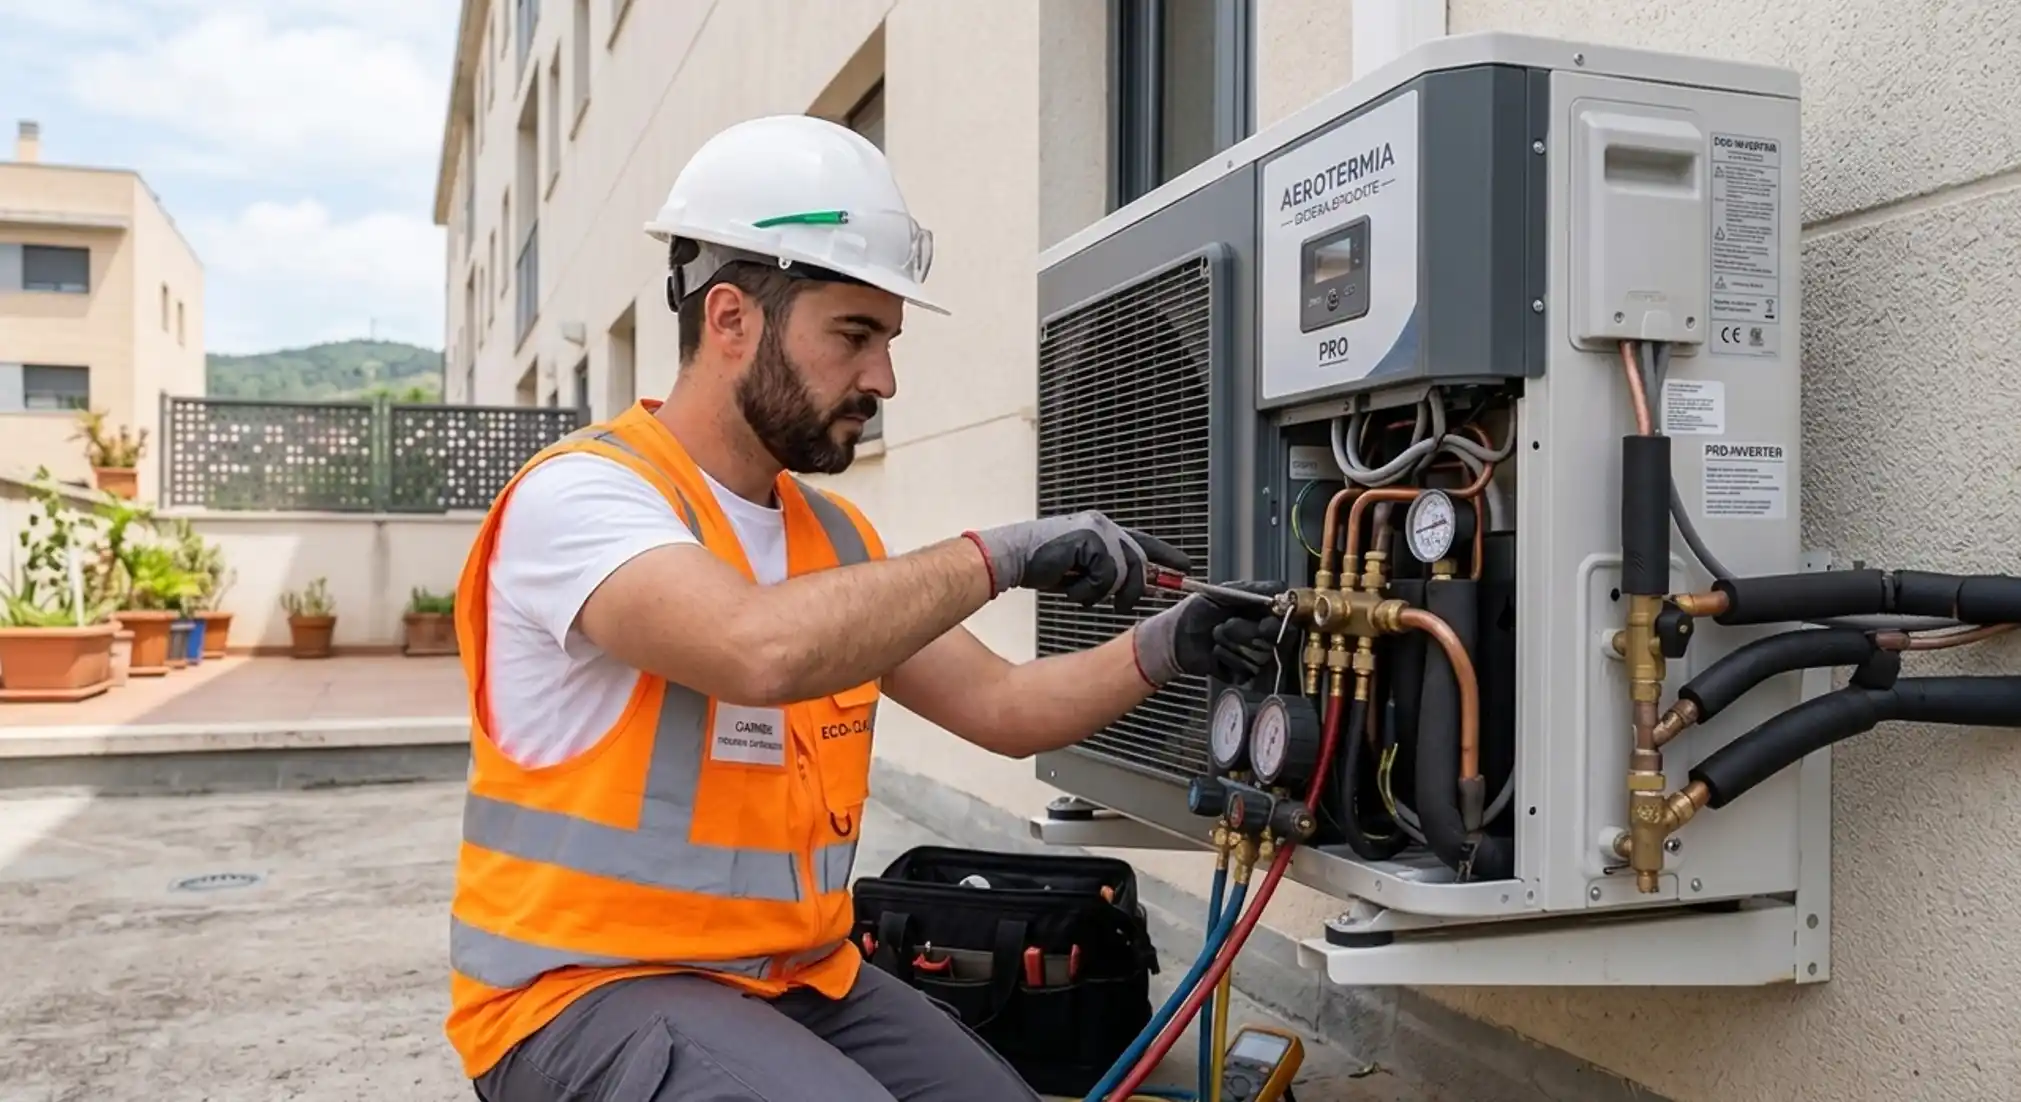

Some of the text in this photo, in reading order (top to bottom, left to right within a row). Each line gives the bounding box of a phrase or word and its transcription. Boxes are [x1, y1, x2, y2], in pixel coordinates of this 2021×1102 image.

[1280, 143, 1395, 211] AEROTERMIA
[1721, 327, 1741, 343] CE
[1319, 337, 1348, 361] PRO
